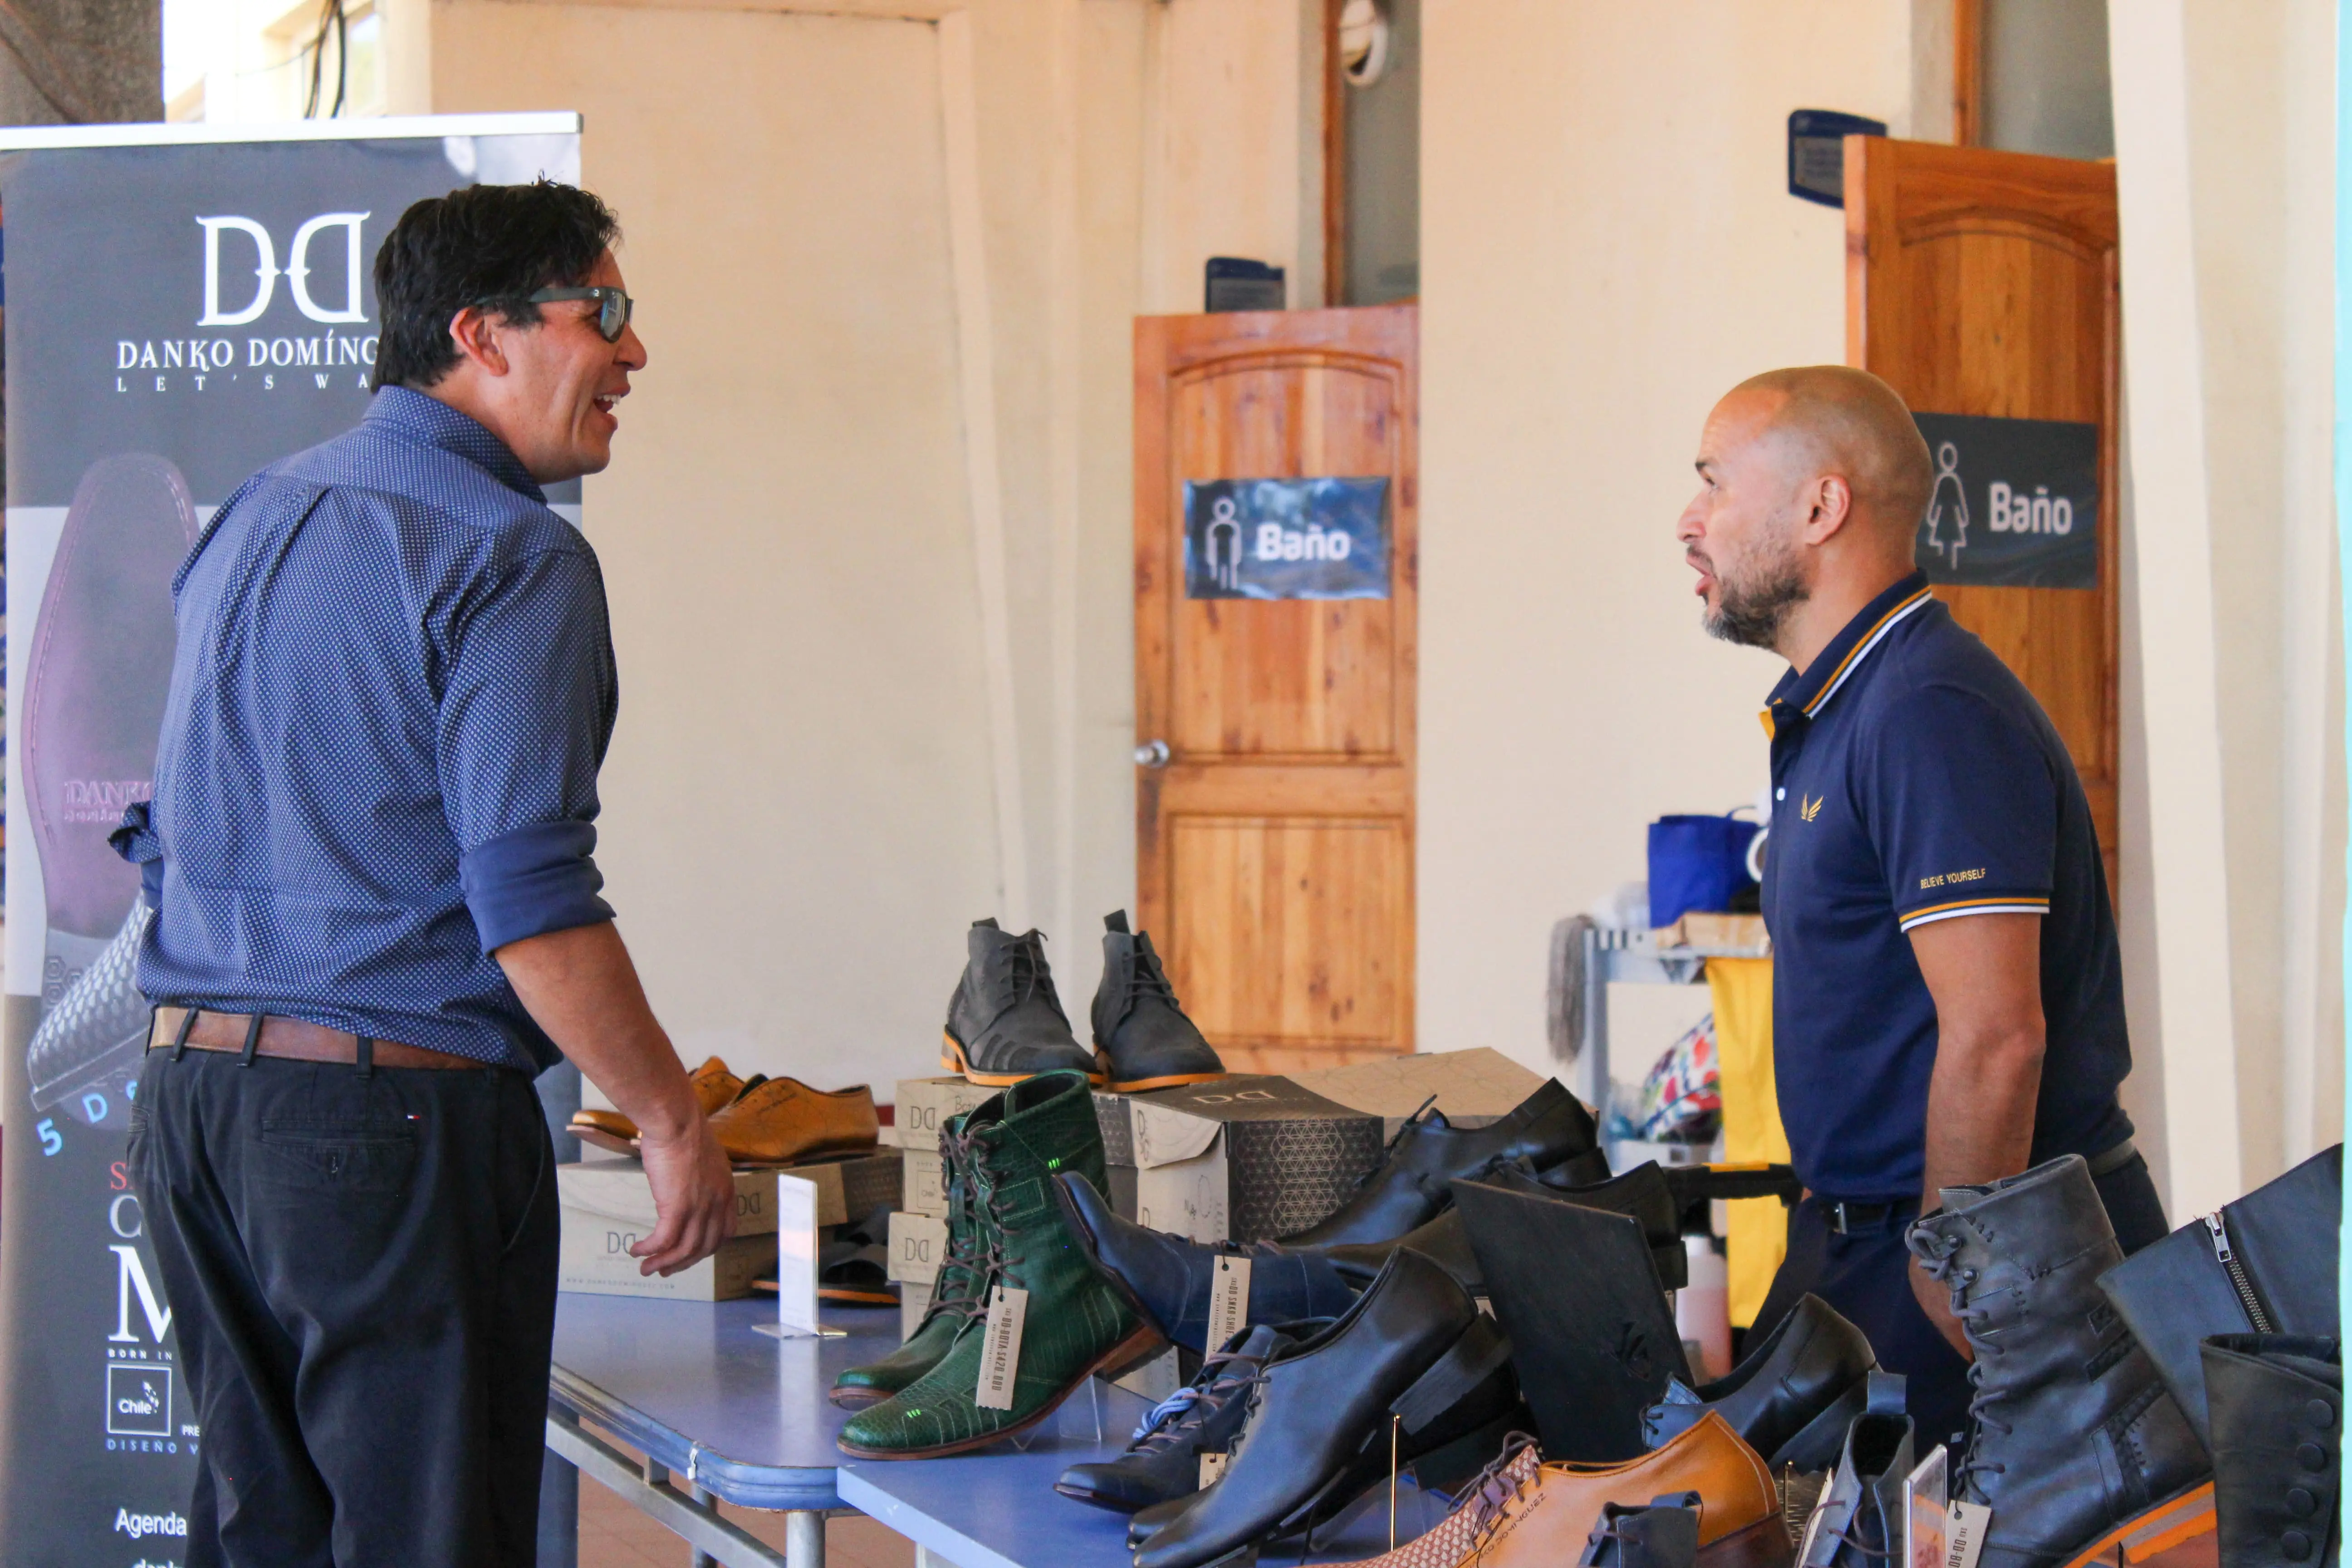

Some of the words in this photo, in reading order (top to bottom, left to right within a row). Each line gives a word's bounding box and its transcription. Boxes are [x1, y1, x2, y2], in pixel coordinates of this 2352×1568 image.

[117, 338, 234, 372] DANKO
[1988, 481, 2073, 536] Baño
[1257, 523, 1352, 562] Baño
[1921, 875, 1945, 889] BELIEVE
[1946, 867, 1986, 883] YOURSELF
[107, 1348, 147, 1359] BORN
[157, 1350, 172, 1360] IN
[118, 1398, 152, 1414] Chile
[106, 1437, 177, 1454] DISEÑO
[115, 1507, 187, 1539] Agenda
